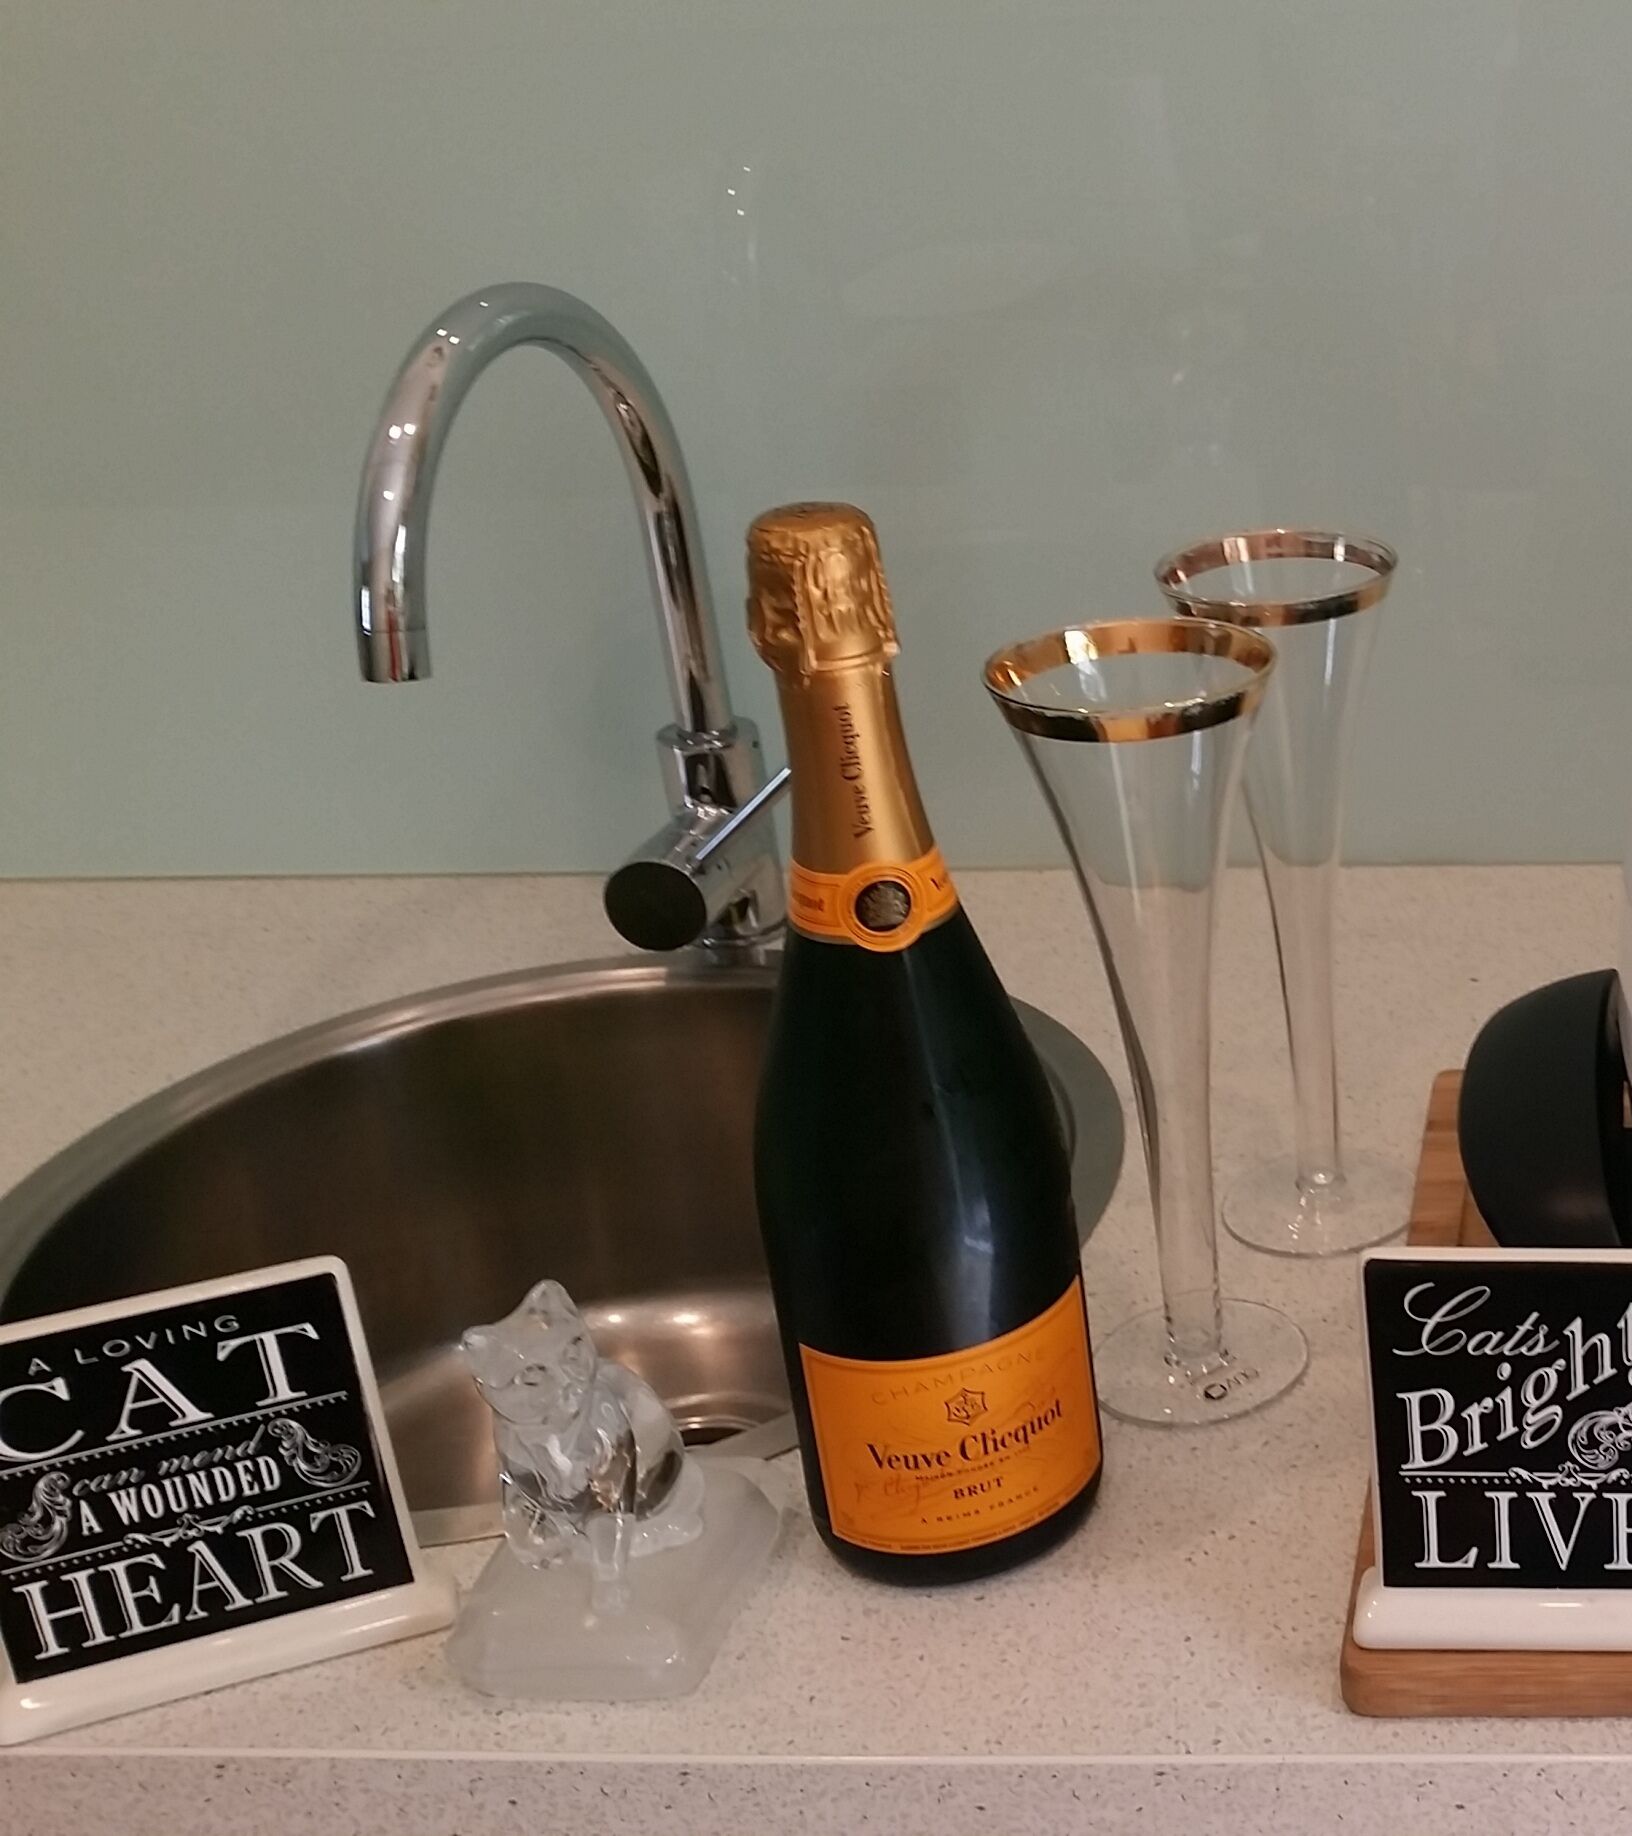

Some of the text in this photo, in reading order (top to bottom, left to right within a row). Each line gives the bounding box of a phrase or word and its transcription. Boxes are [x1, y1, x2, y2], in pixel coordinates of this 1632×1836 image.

[832, 702, 875, 838] Veuve Clicquot
[28, 1314, 241, 1376] A LOVING
[1392, 1281, 1560, 1357] Cats
[0, 1322, 321, 1463] CAT
[72, 1424, 266, 1496] can mend
[866, 1442, 951, 1471] Veuve
[959, 1399, 1063, 1462] Clicquot
[79, 1455, 282, 1537] A WOUNDED
[953, 1476, 1004, 1500] BRUT
[13, 1500, 377, 1661] HEART
